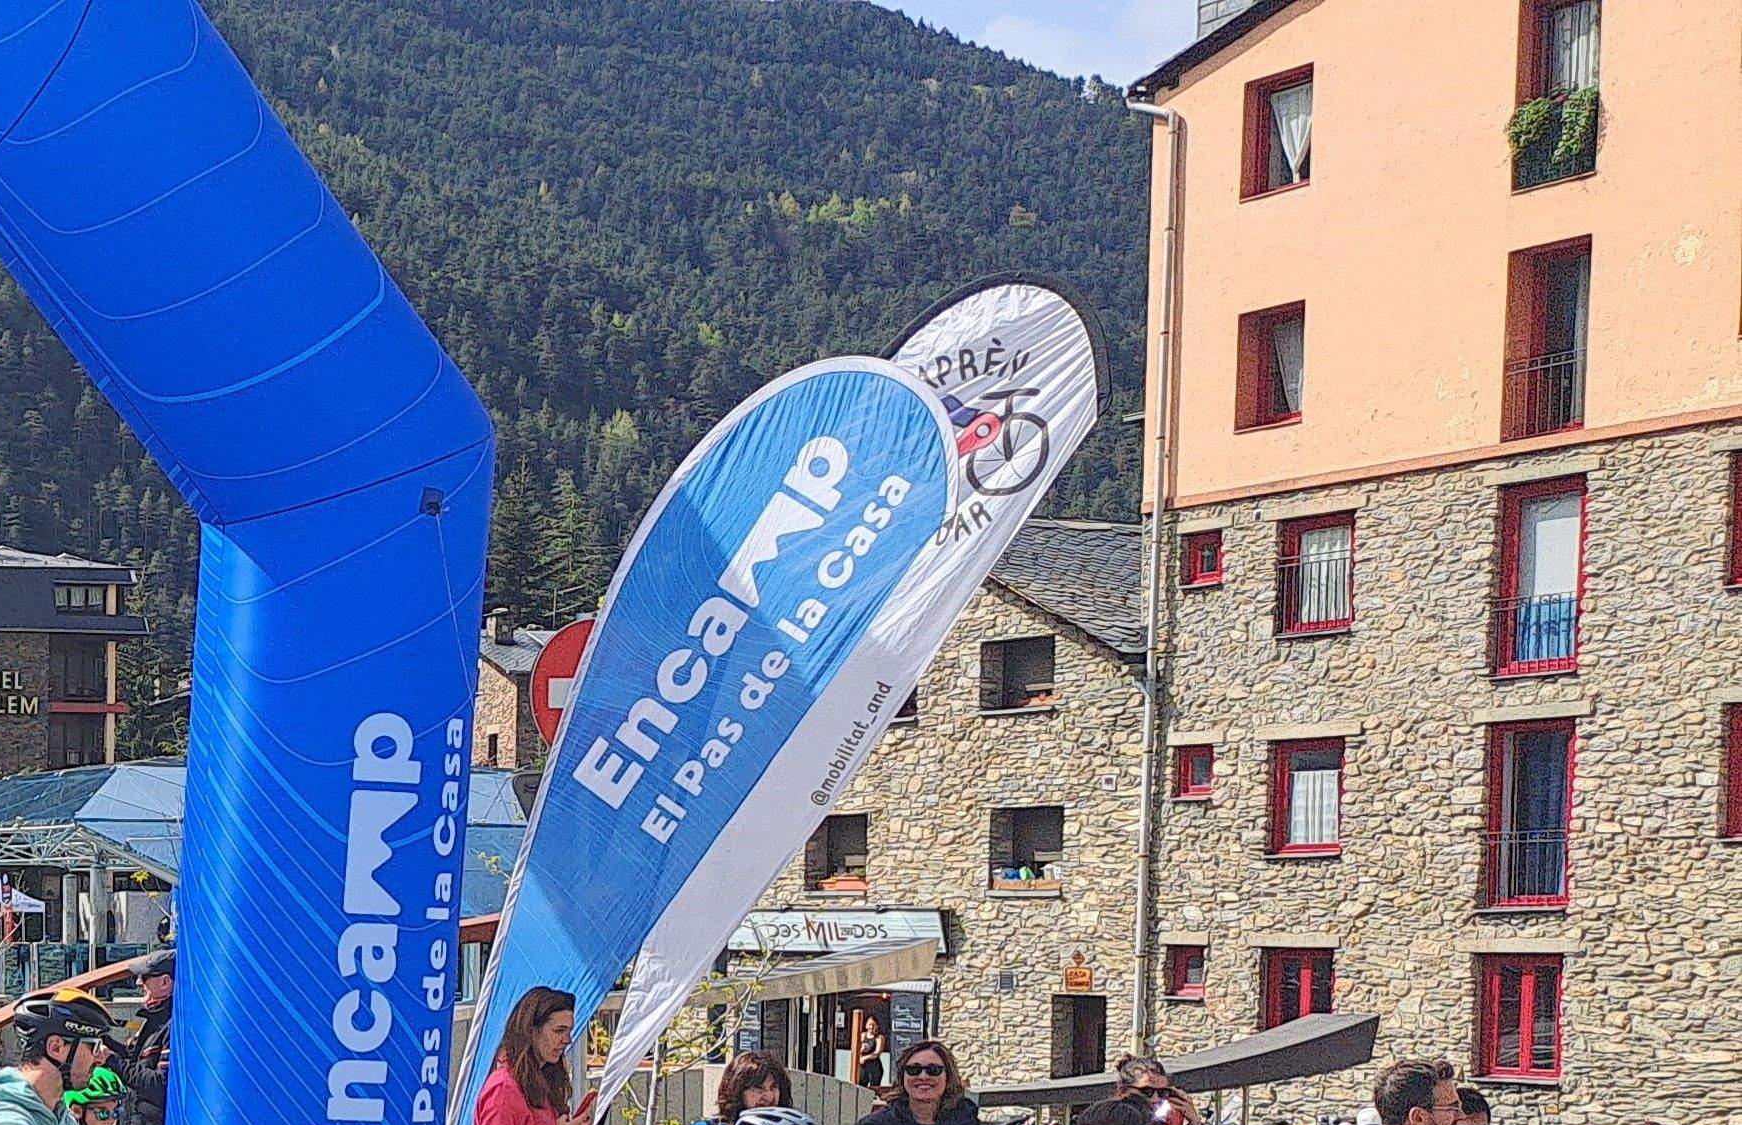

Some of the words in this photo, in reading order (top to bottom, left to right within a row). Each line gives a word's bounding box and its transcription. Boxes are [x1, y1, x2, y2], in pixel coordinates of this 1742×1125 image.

[572, 434, 851, 811] Encamp
[640, 793, 687, 845] El
[673, 716, 744, 797] Pas
[740, 650, 792, 711] de
[776, 598, 827, 645] la
[818, 474, 912, 589] Casa
[432, 718, 465, 856] Casa
[810, 680, 893, 807] @mobilitat_and
[425, 872, 453, 920] la
[804, 912, 848, 949] MIL
[422, 938, 450, 1011] de
[64, 1020, 103, 1036] RUDY
[410, 1028, 441, 1123] Pas
